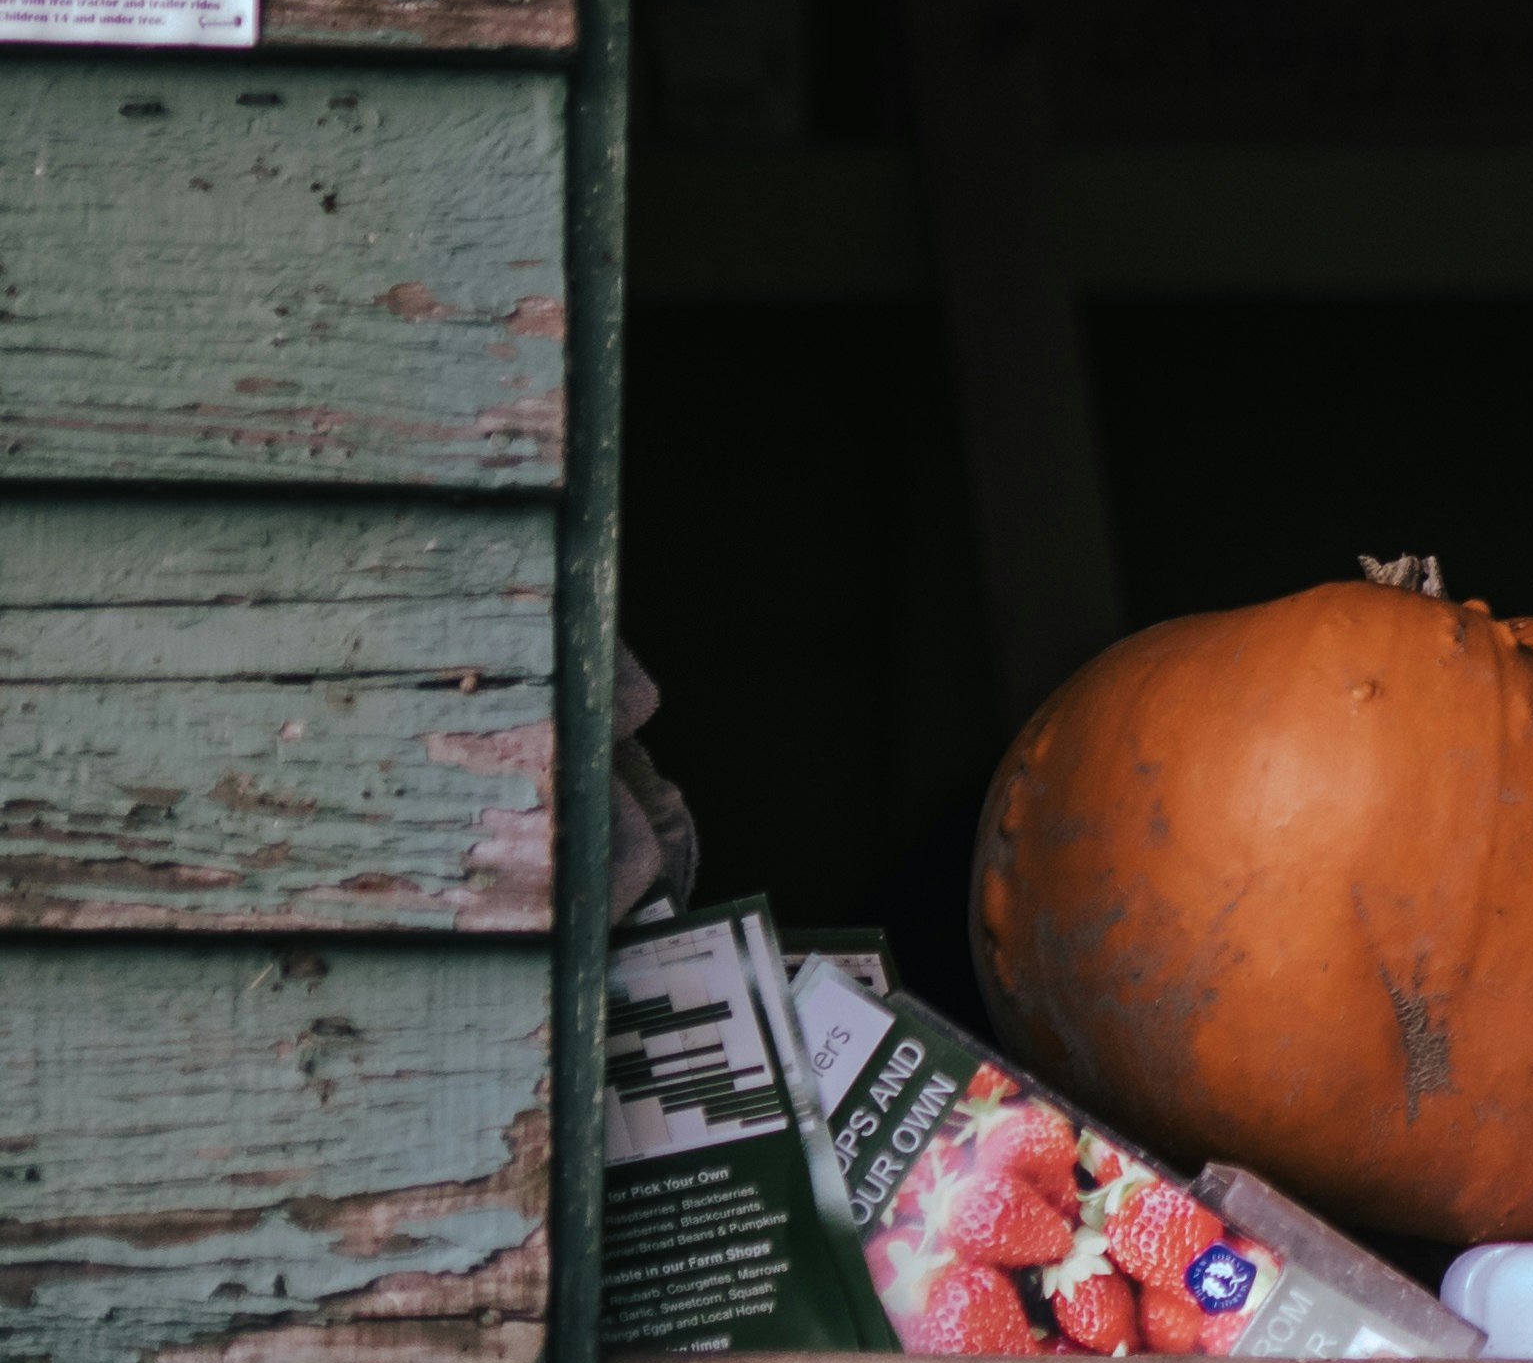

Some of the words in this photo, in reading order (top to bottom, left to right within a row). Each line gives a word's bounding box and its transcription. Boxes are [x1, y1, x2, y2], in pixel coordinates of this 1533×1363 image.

[72, 12, 96, 25] and
[191, 0, 221, 10] rides
[869, 1036, 926, 1113] AND
[891, 1070, 958, 1155] OWN
[630, 1181, 661, 1198] Pick
[662, 1174, 695, 1191] Your
[697, 1167, 730, 1184] Own
[681, 1185, 760, 1212] Blackberries,
[677, 1228, 715, 1246] Beans
[717, 1225, 727, 1237] &
[729, 1211, 788, 1235] Pumpkins
[679, 1202, 766, 1229] Blackcurrants,
[645, 1262, 659, 1277] in
[662, 1259, 685, 1275] our
[687, 1251, 724, 1269] Farm
[725, 1241, 772, 1263] Shops
[666, 1274, 736, 1297] Courgettes,
[737, 1261, 789, 1280] Marrows
[660, 1293, 727, 1315] Sweetcorn,
[727, 1281, 778, 1302] Squash,
[642, 1319, 674, 1338] Eggs
[676, 1313, 699, 1328] and
[700, 1308, 733, 1326] Local
[735, 1299, 776, 1319] Honey
[690, 1335, 730, 1352] times
